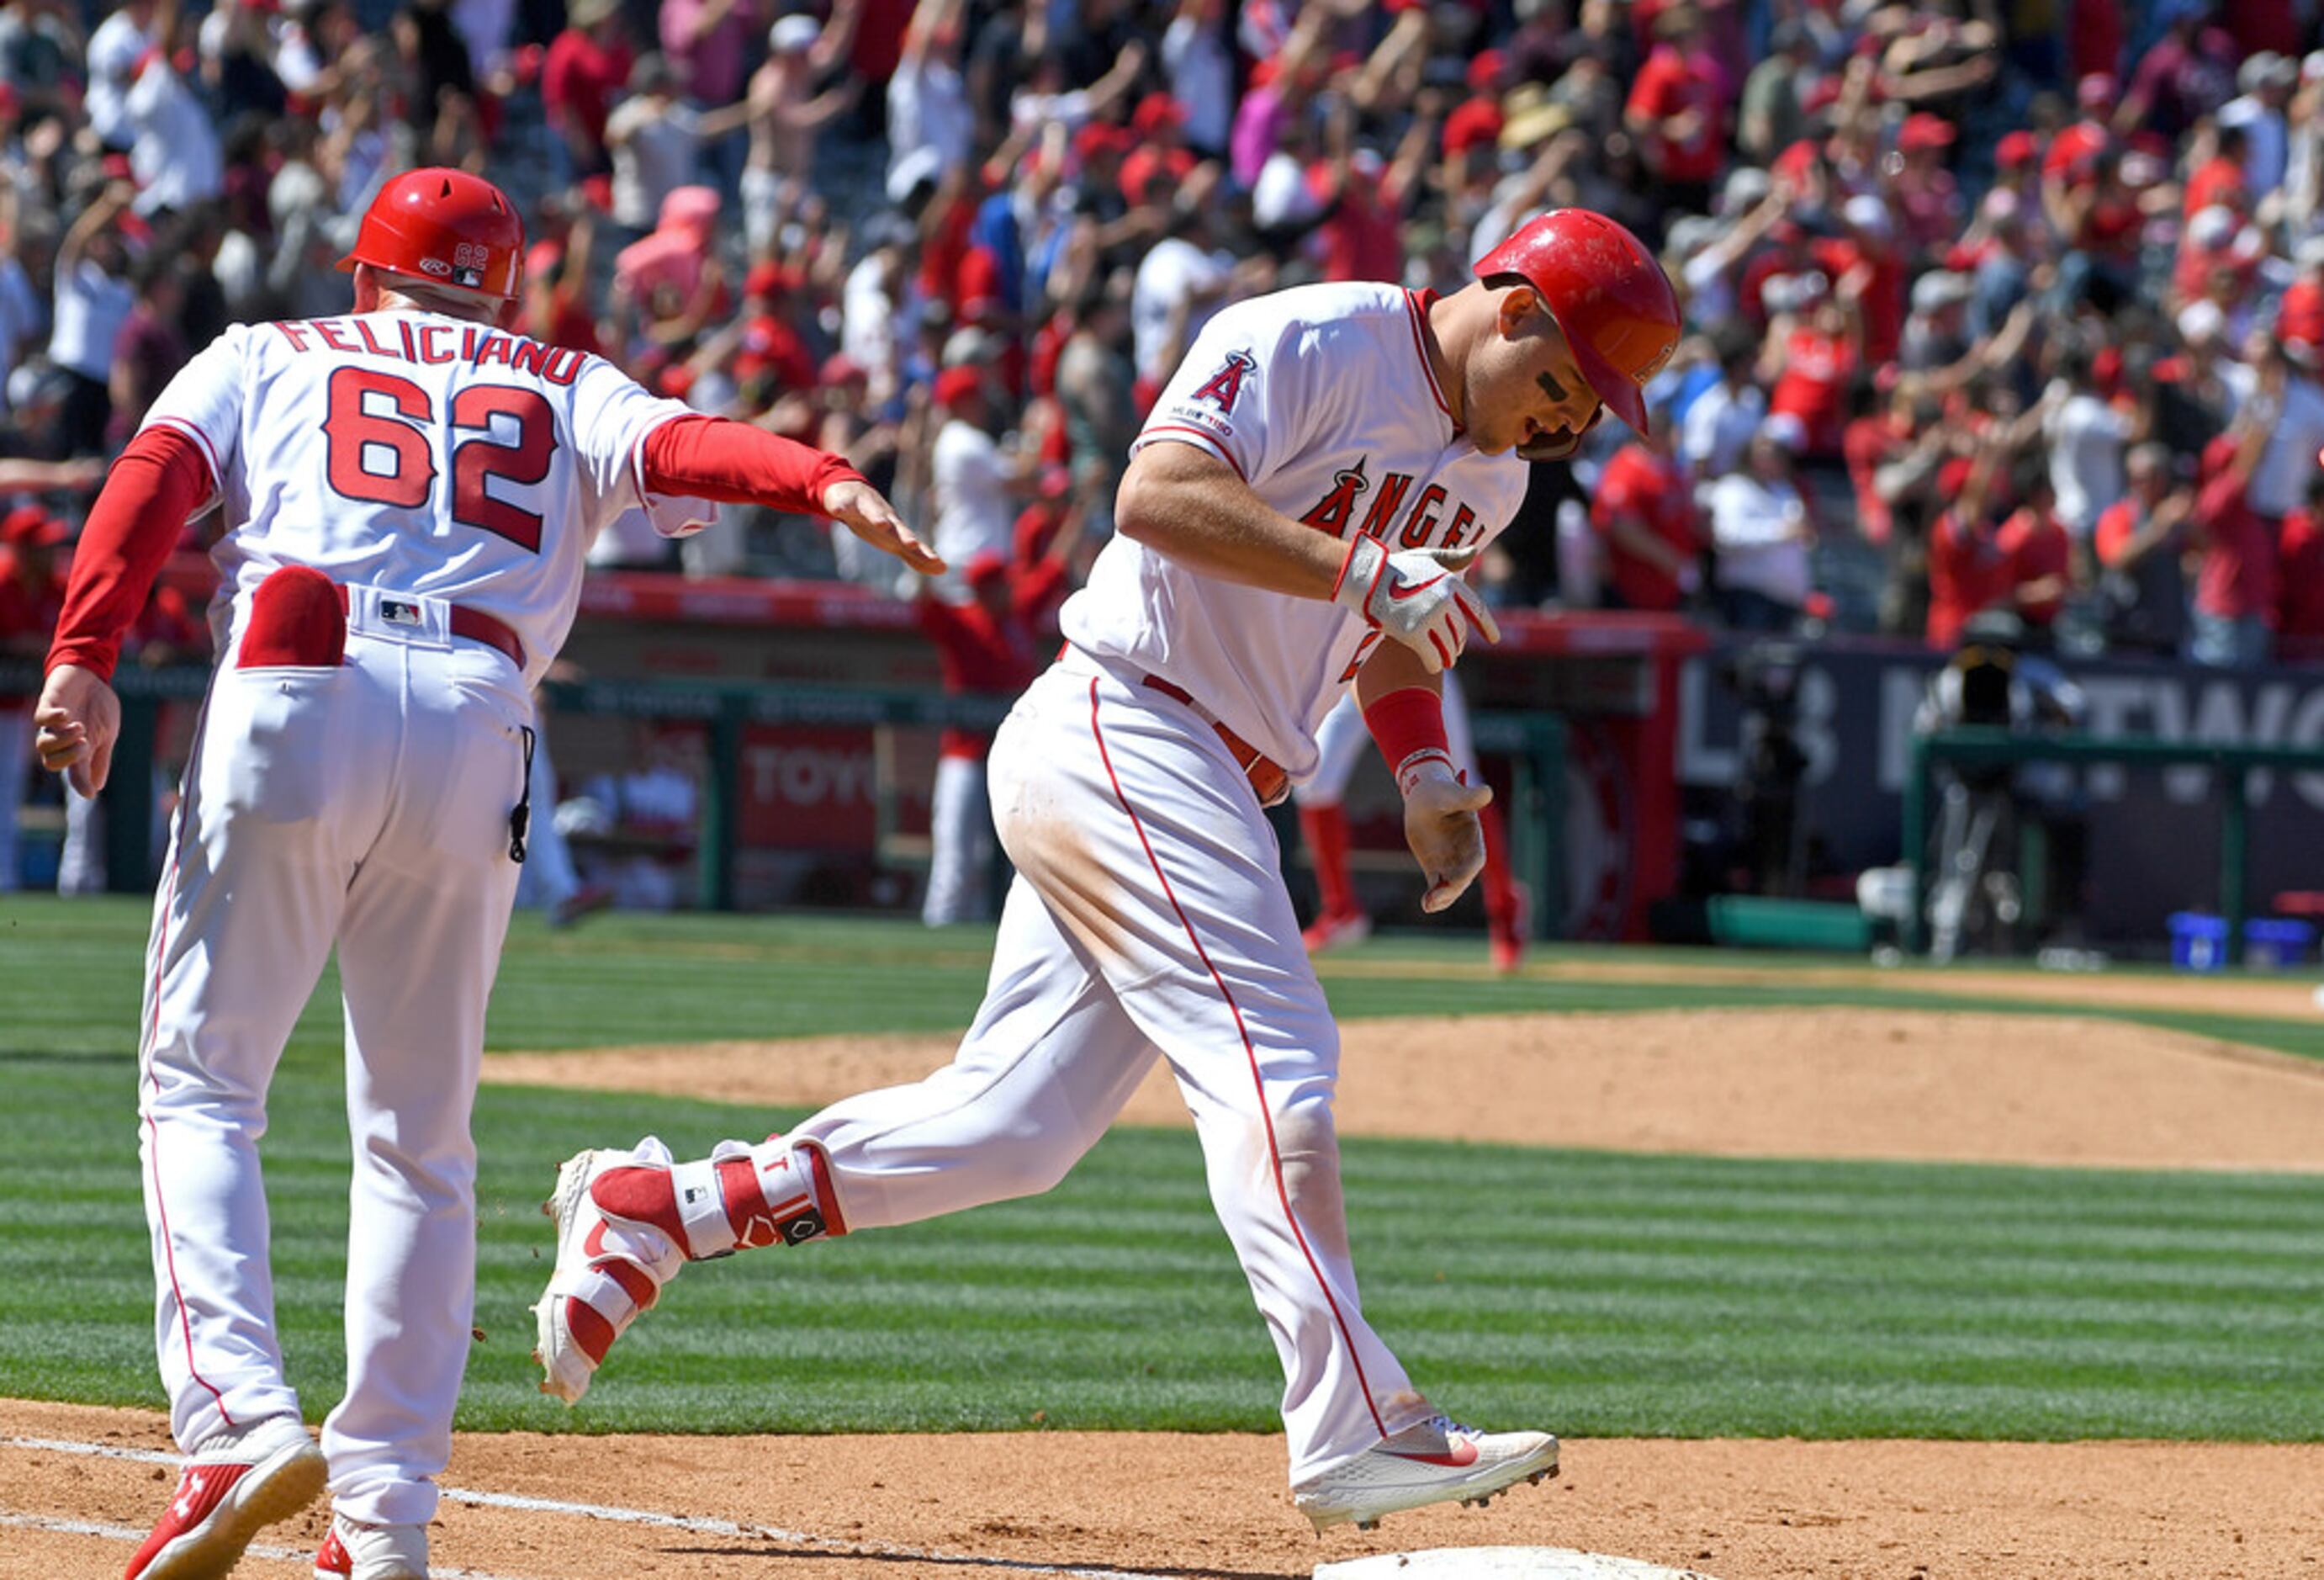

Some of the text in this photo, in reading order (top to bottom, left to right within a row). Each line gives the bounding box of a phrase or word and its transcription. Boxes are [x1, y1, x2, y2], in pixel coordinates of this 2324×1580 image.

[454, 242, 489, 270] 62
[273, 317, 588, 387] FELICIANO
[320, 365, 559, 555] 62
[1298, 454, 1486, 549] ANGE
[744, 745, 876, 806] TOY
